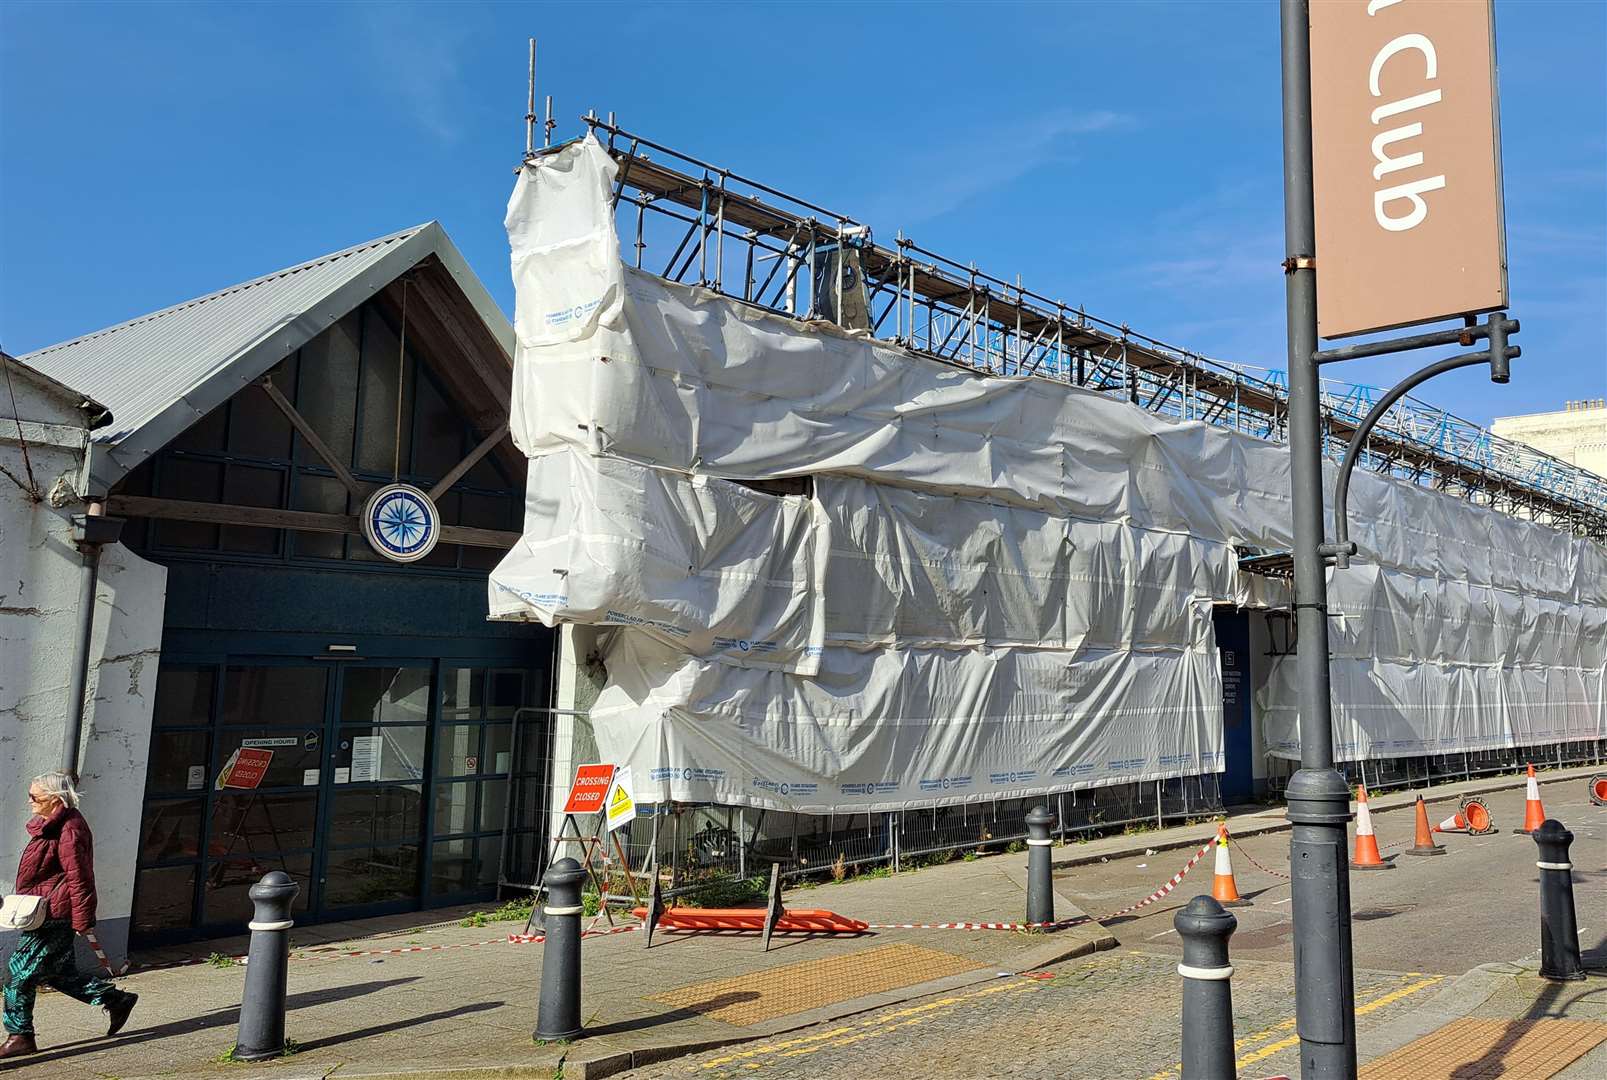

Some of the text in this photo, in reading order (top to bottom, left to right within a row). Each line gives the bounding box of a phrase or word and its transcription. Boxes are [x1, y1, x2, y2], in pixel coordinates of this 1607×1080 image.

[1369, 33, 1446, 232] Club
[576, 776, 609, 786] CROSSING
[574, 792, 601, 801] CLOSED
